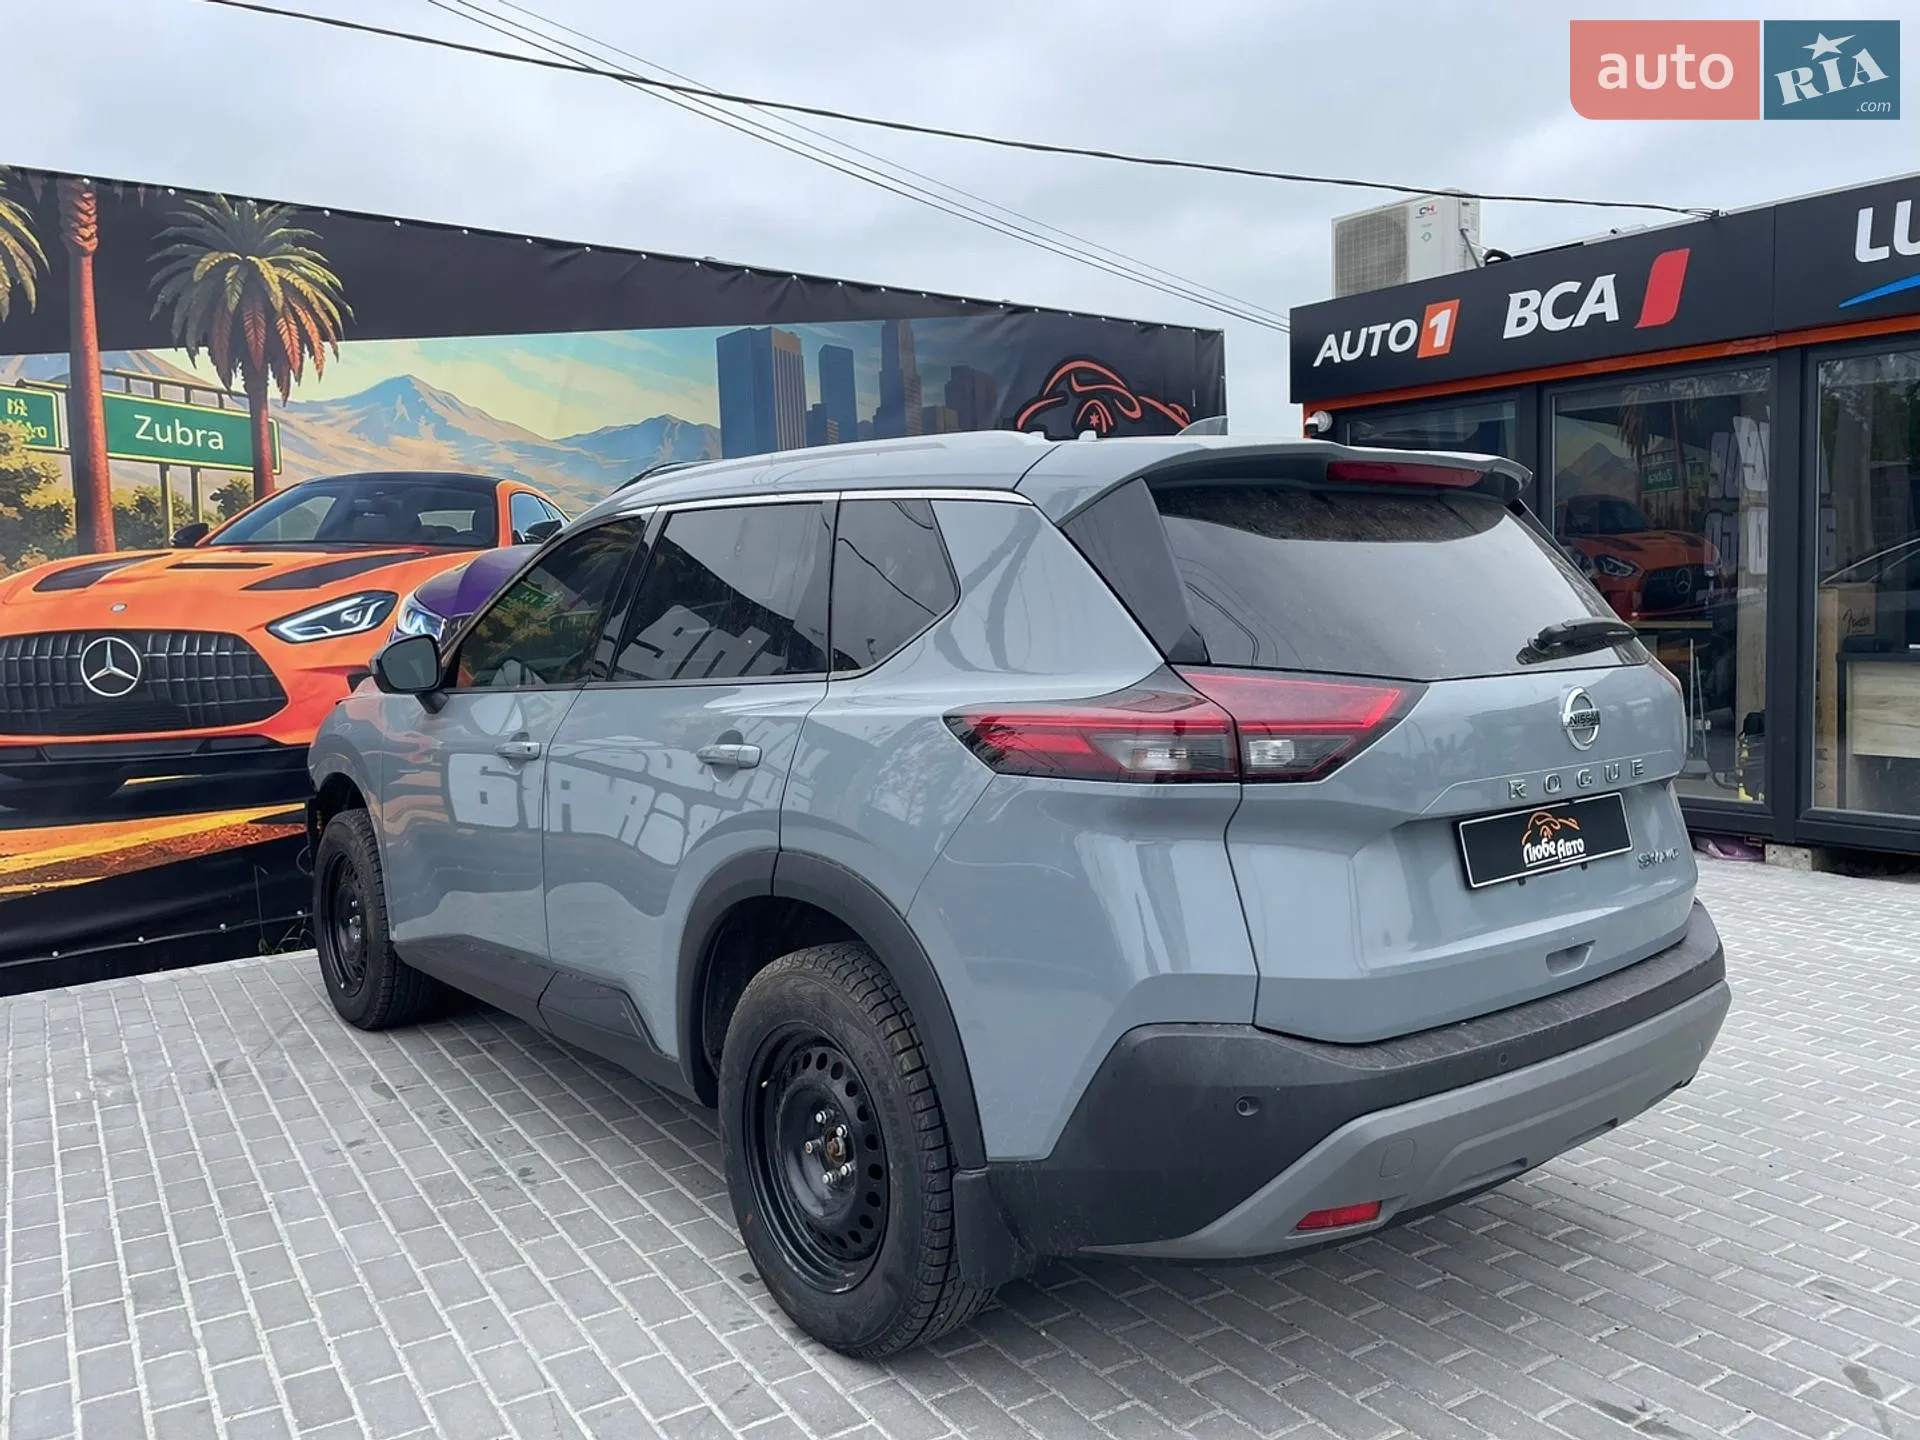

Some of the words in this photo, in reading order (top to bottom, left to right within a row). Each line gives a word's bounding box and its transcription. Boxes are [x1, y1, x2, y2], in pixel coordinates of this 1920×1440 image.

[1503, 273, 1619, 339] BCA
[134, 414, 225, 450] Zubra
[1508, 758, 1644, 799] ROGUE
[1523, 837, 1556, 864] Любе
